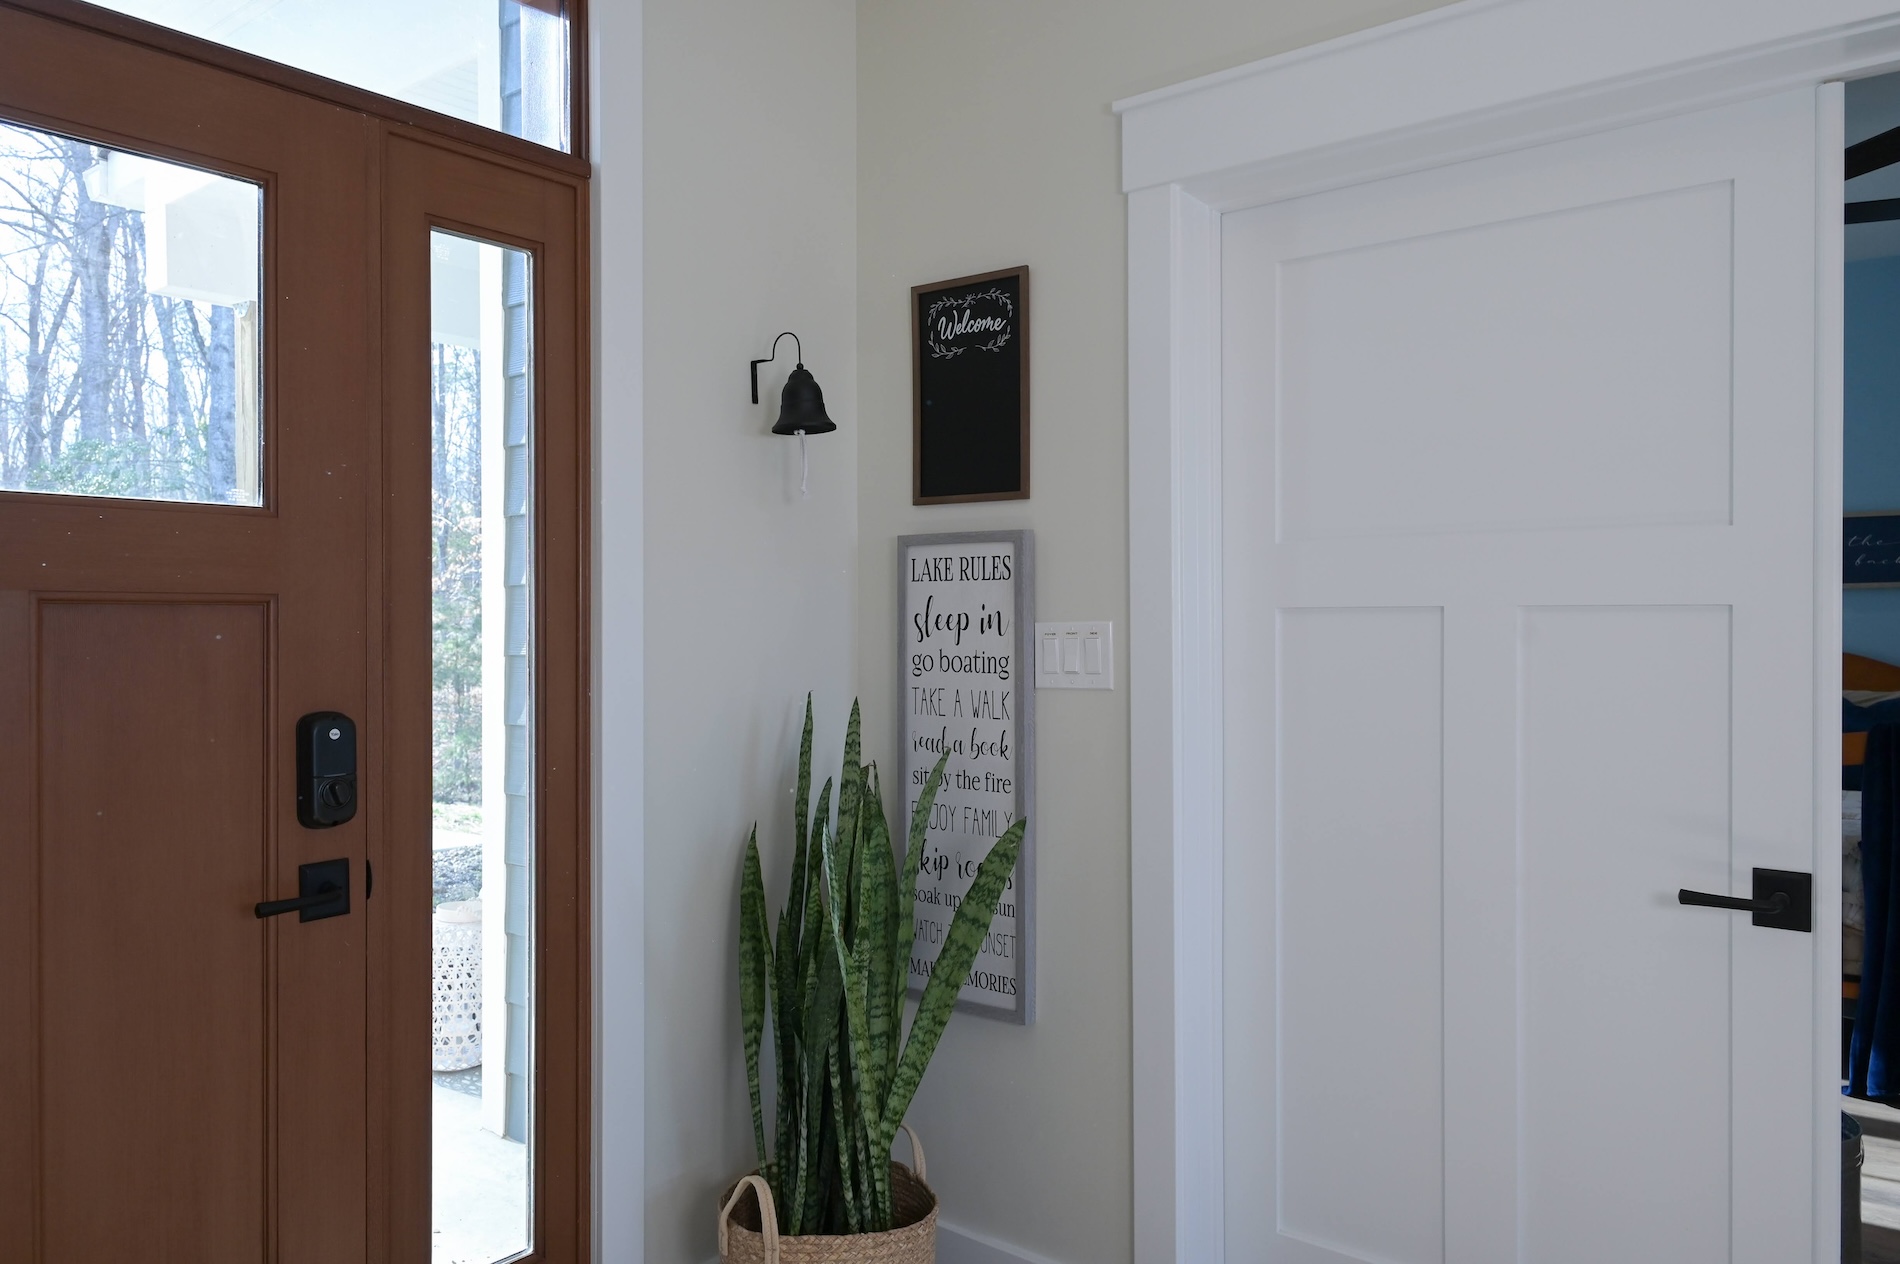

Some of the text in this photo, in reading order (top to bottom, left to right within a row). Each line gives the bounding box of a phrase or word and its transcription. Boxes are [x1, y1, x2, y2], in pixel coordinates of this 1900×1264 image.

[938, 308, 1007, 340] Welcome
[1848, 533, 1884, 547] the
[911, 555, 1011, 582] LAKE RULES
[913, 594, 1010, 646] sleep in
[912, 648, 1010, 680] go boating
[911, 686, 1010, 720] TAKE A WALK
[911, 726, 1013, 761] read a book
[912, 766, 930, 785] sit
[955, 769, 981, 791] the
[985, 771, 1012, 794] fire
[911, 800, 1013, 839] EJOY FAMILY
[917, 838, 949, 881] kip
[914, 886, 941, 906] soak
[945, 893, 962, 912] up
[980, 931, 1016, 959] UNSET
[964, 970, 1017, 996] MORIES
